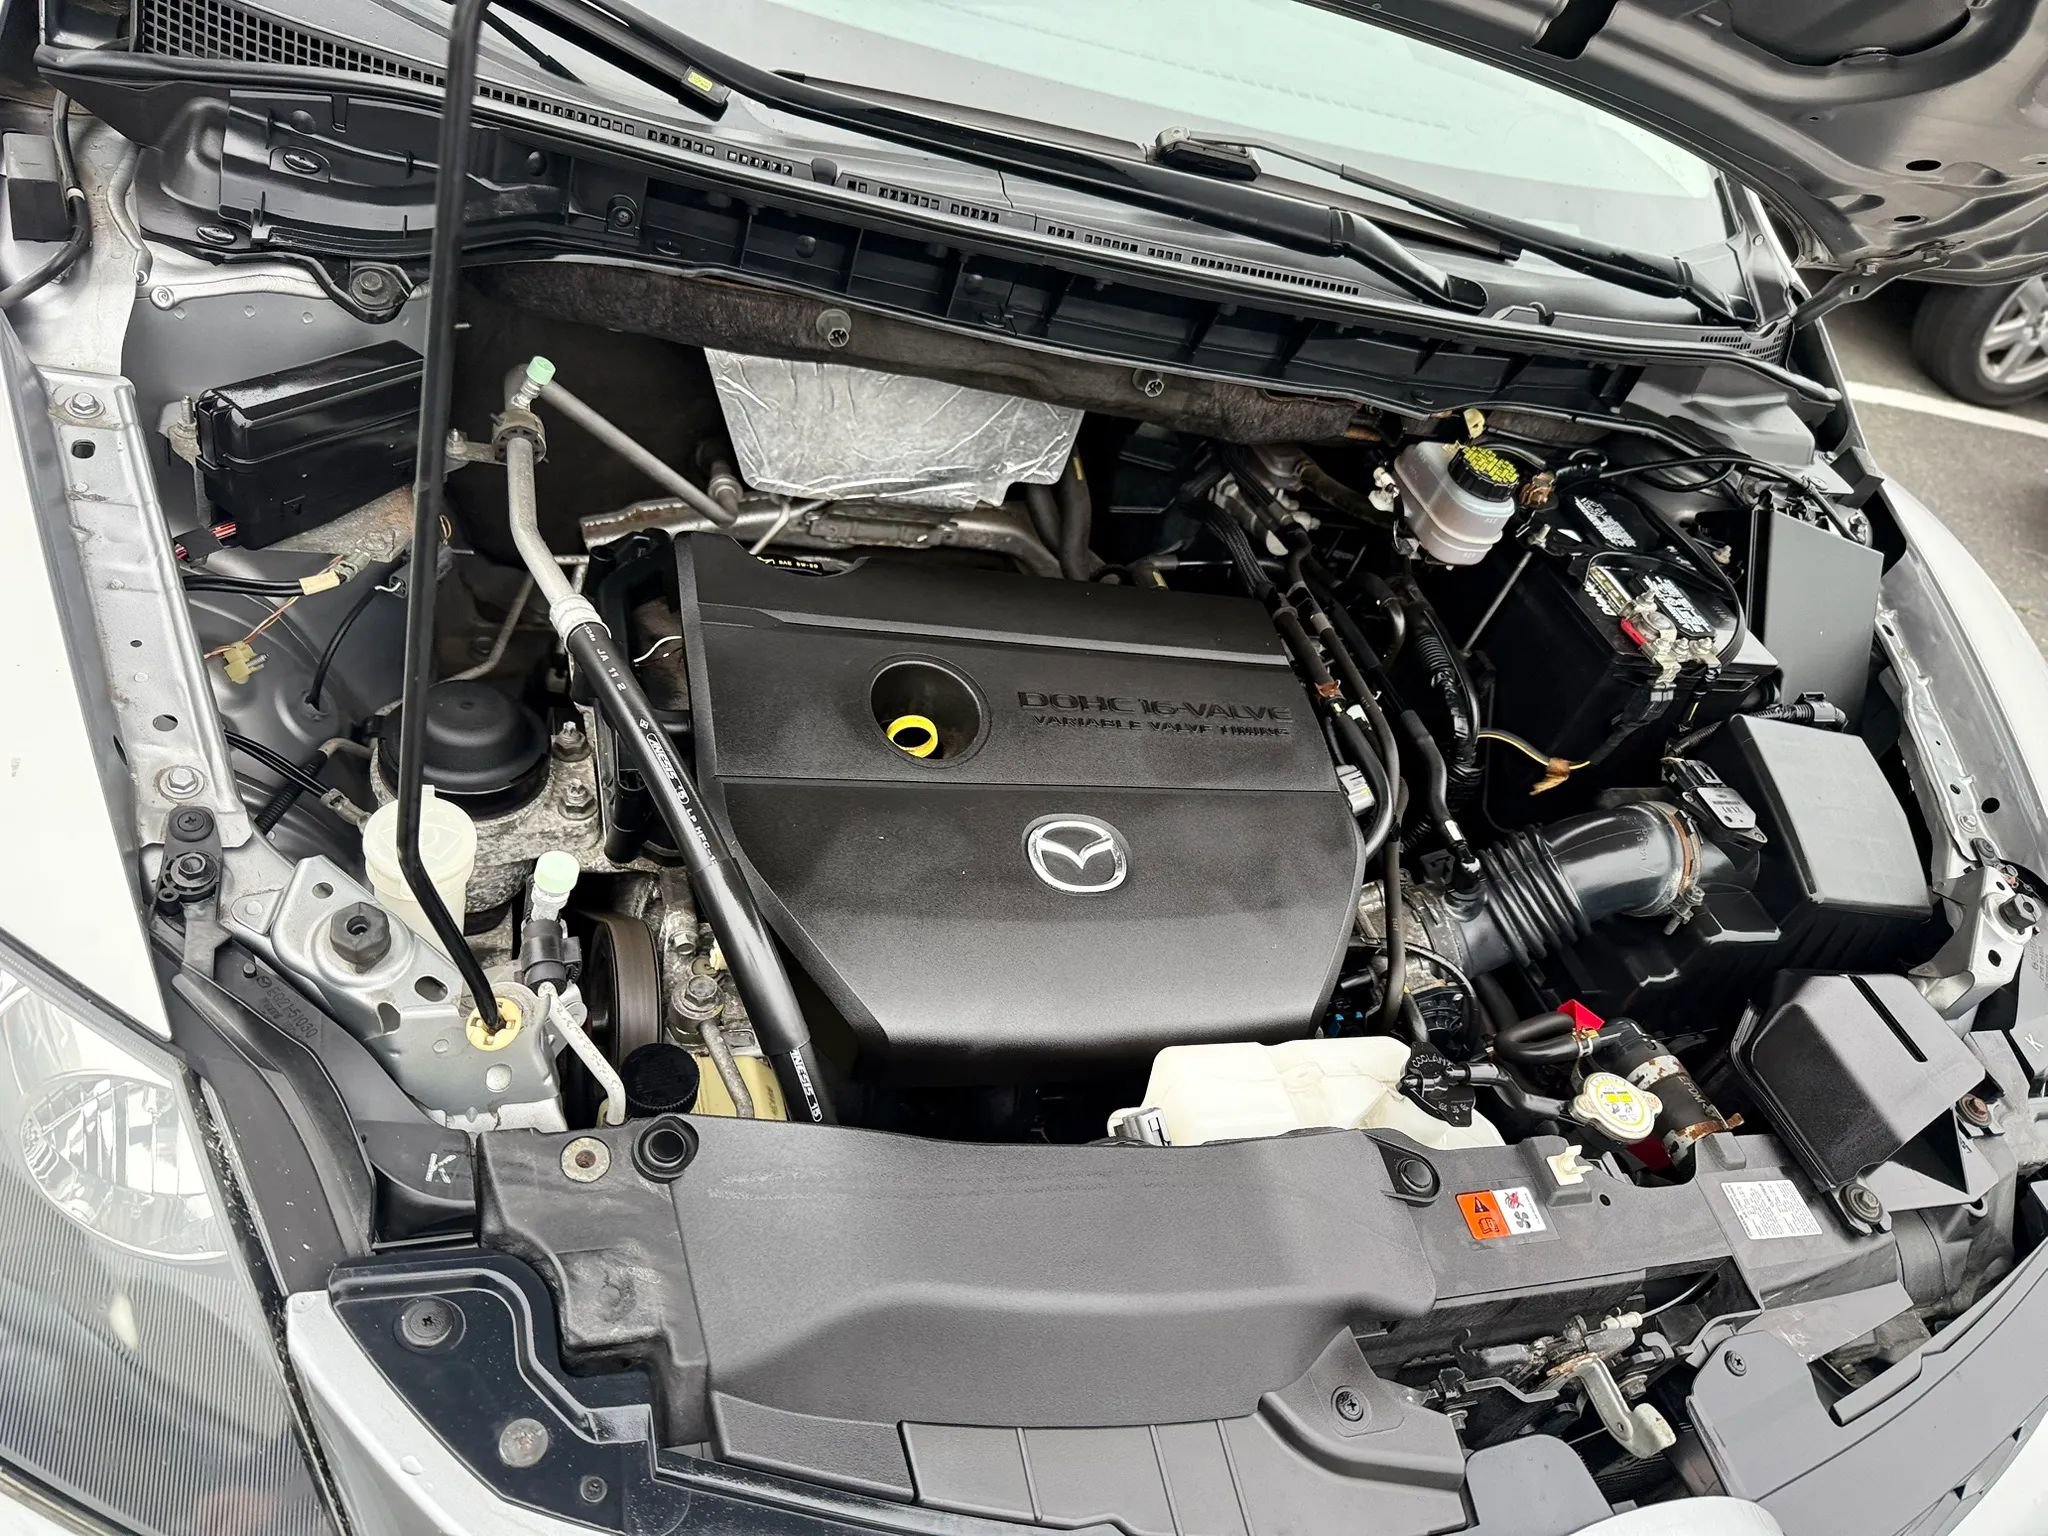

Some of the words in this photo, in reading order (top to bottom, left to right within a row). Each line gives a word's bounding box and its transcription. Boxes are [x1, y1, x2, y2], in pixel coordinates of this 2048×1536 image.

[1017, 691, 1135, 713] DOHC
[1138, 698, 1293, 722] 16-VALVE
[596, 648, 610, 663] JA
[616, 682, 627, 691] 2
[685, 808, 698, 823] LP
[1032, 714, 1143, 730] VARIABLE
[1147, 720, 1213, 734] VALVE
[2024, 1032, 2045, 1053] K
[425, 1152, 457, 1184] K
